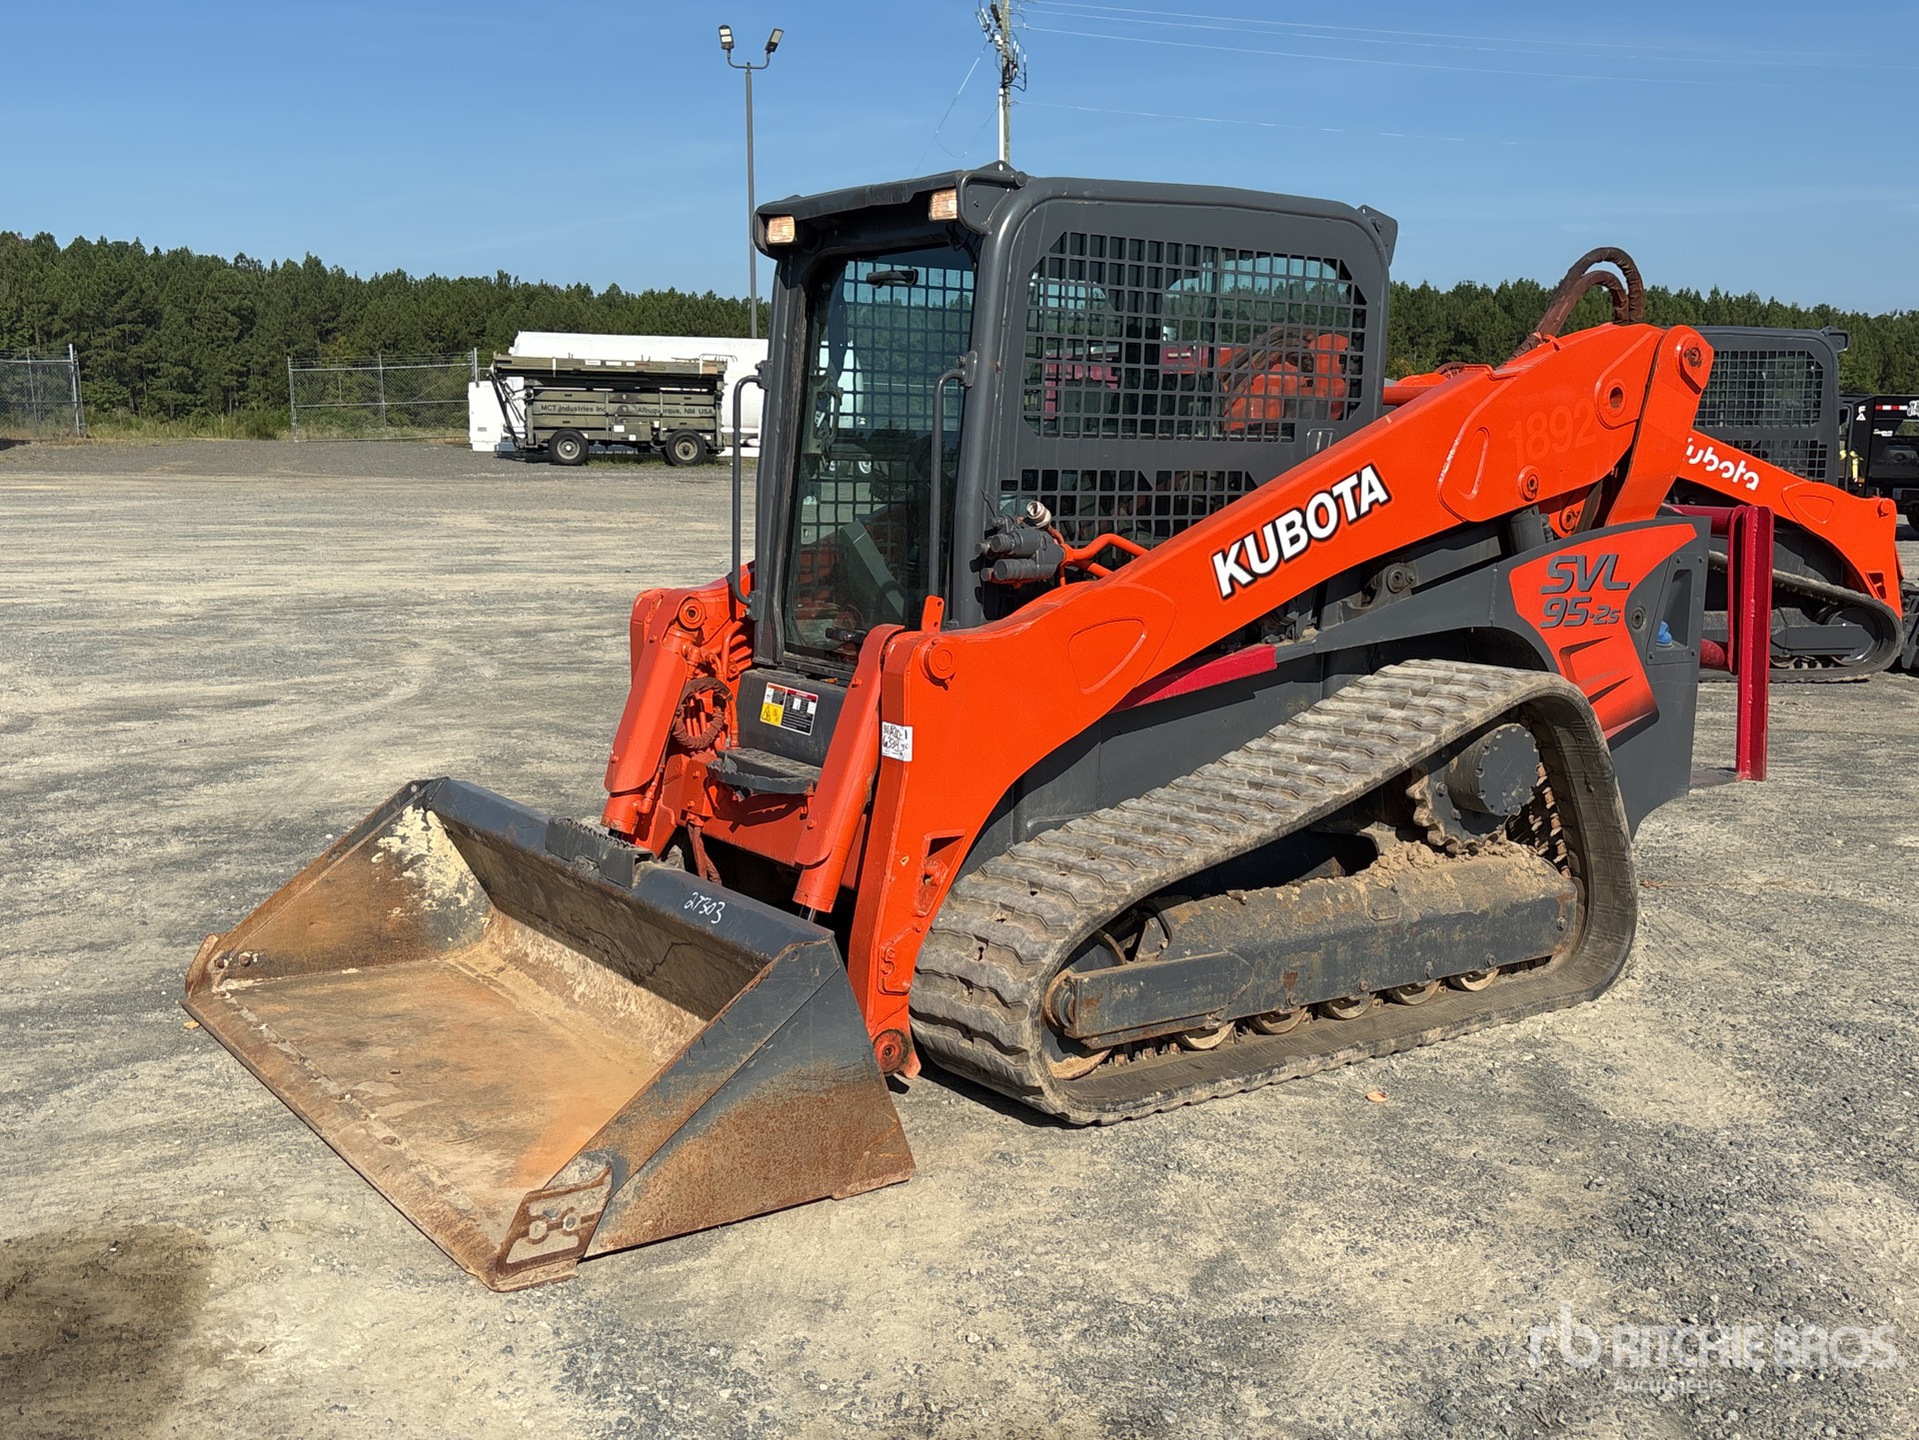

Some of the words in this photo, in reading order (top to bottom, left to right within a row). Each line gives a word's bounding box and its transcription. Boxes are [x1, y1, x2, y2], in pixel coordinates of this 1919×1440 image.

[1686, 437, 1760, 491] ubota
[1212, 465, 1391, 598] KUBOTA
[1540, 554, 1631, 594] SVL
